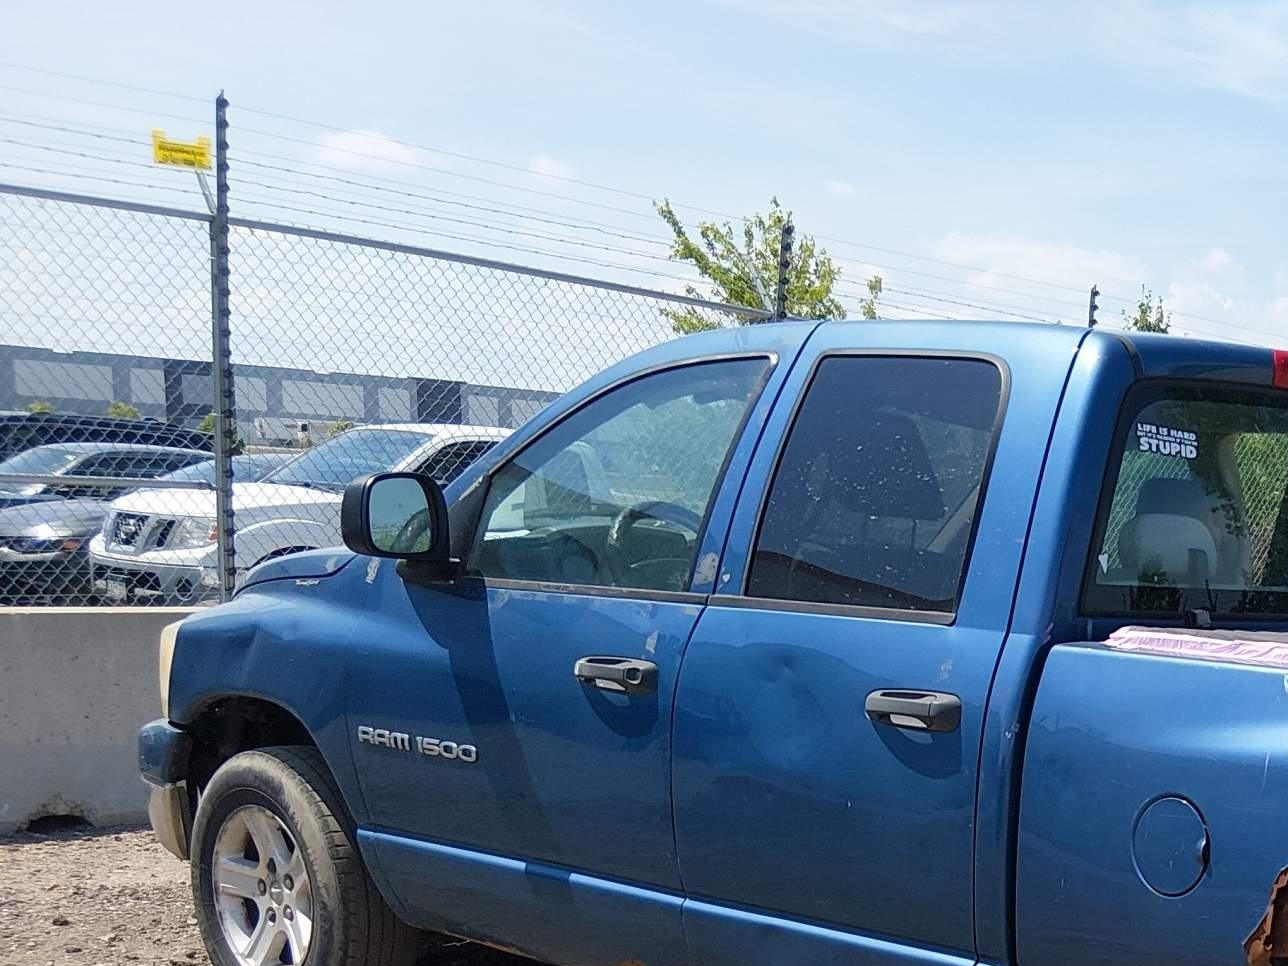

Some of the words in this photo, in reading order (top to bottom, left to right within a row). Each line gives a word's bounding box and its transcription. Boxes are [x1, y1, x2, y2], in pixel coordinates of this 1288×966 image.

[1137, 422, 1157, 434] LIFE
[1158, 427, 1168, 436] IS
[1170, 429, 1197, 441] HARD
[1139, 436, 1197, 459] STUPID
[358, 725, 410, 751] RAM
[416, 736, 477, 762] 1500
